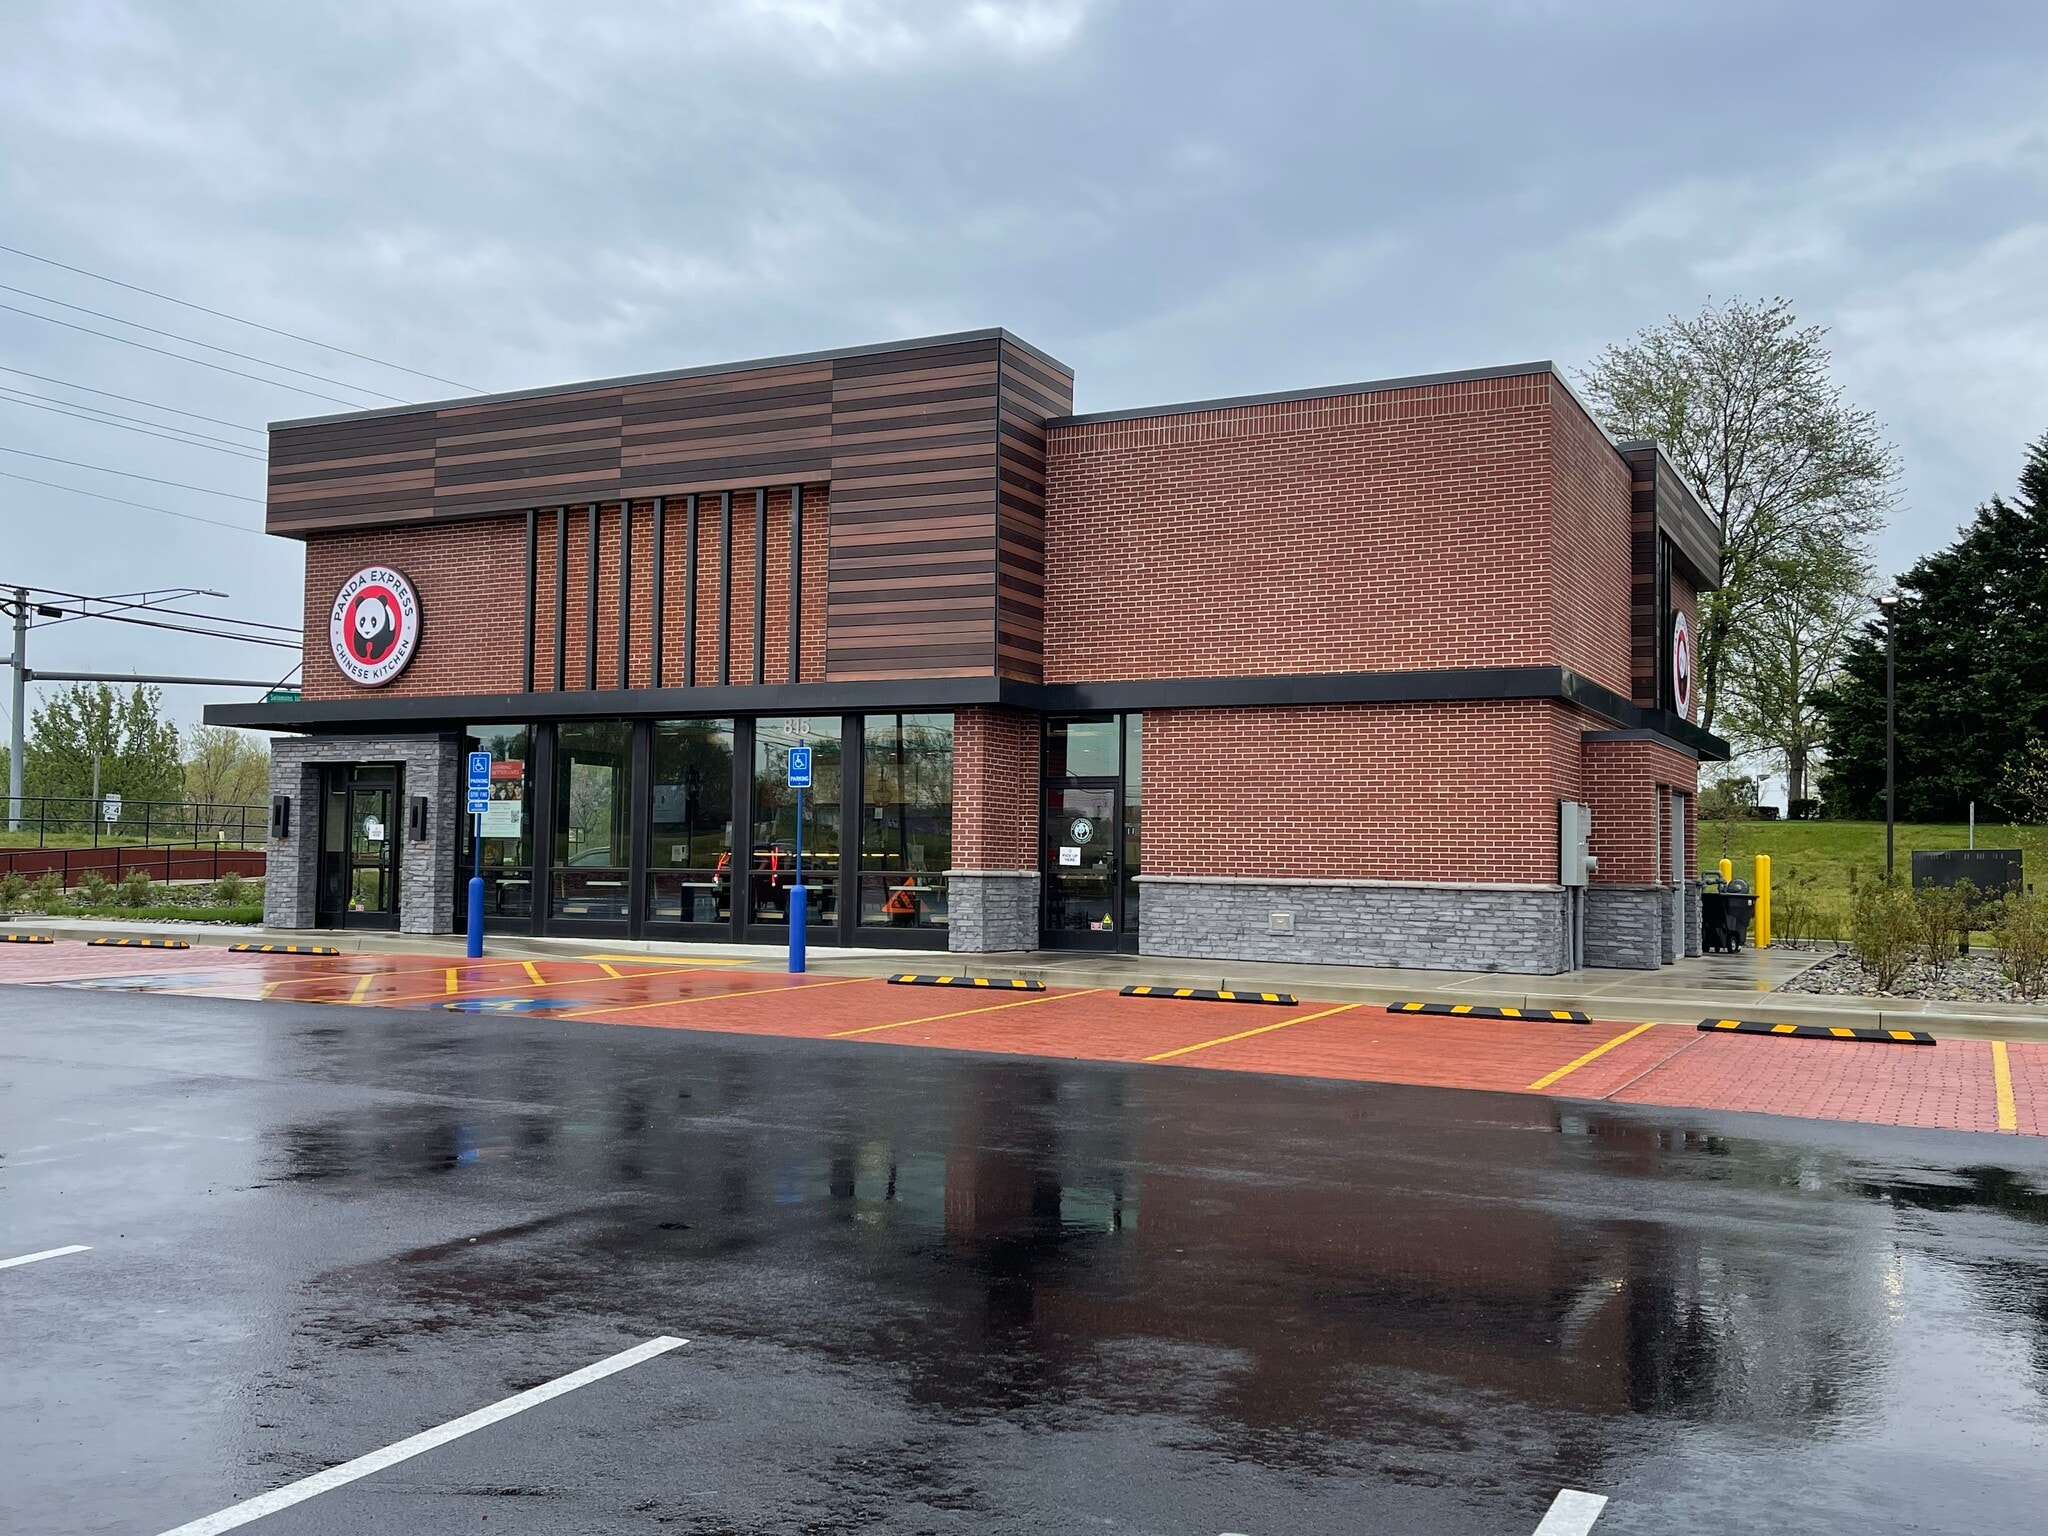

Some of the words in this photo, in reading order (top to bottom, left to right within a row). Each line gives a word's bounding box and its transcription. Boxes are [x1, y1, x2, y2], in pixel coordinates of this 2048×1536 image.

[334, 575, 367, 621] PANDA
[370, 570, 414, 617] EXPRESS
[336, 643, 369, 679] CHINESE
[372, 639, 409, 679] KITCHEN
